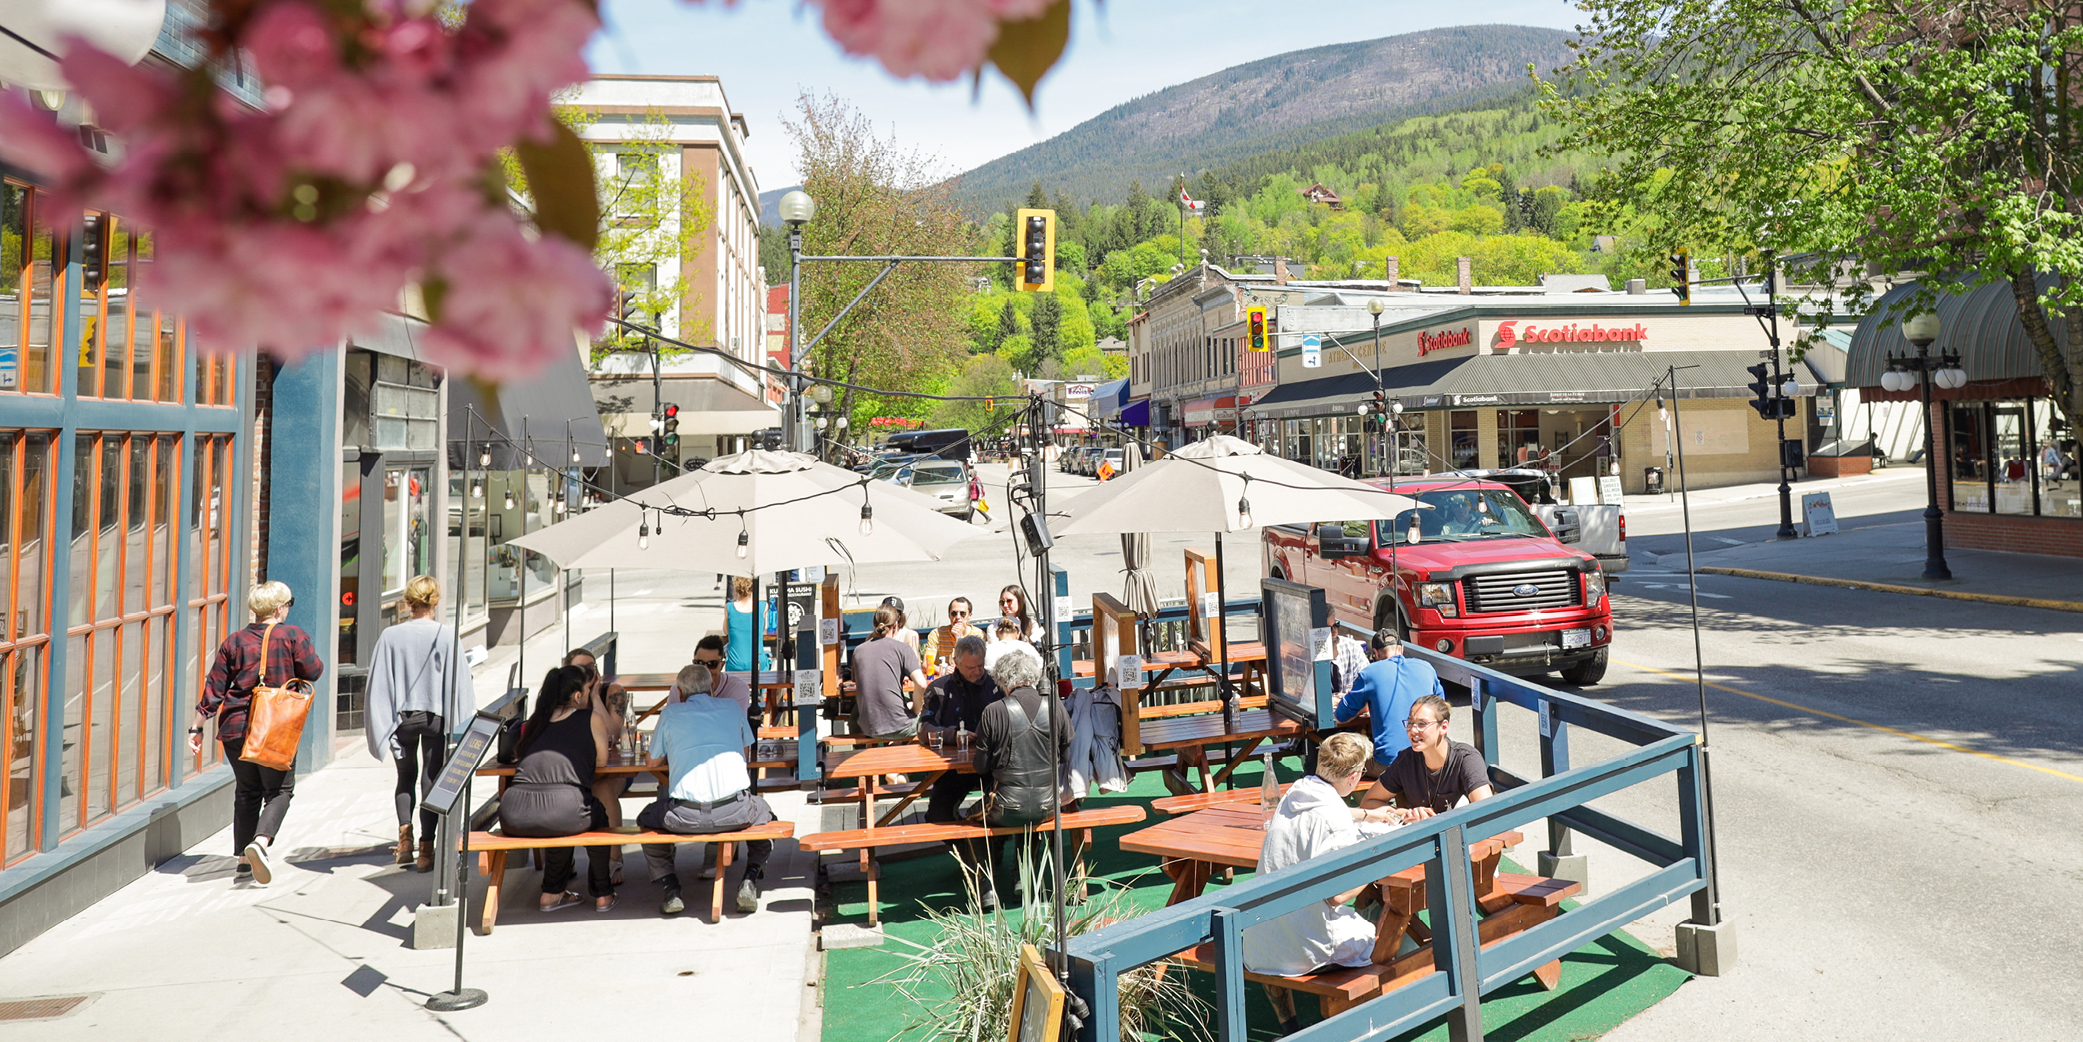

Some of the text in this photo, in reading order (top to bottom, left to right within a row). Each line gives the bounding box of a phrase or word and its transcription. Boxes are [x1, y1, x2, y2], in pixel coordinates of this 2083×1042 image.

[1425, 327, 1470, 351] Scotiabank
[1525, 323, 1648, 343] Scotiabank
[1328, 347, 1355, 363] ATHENS
